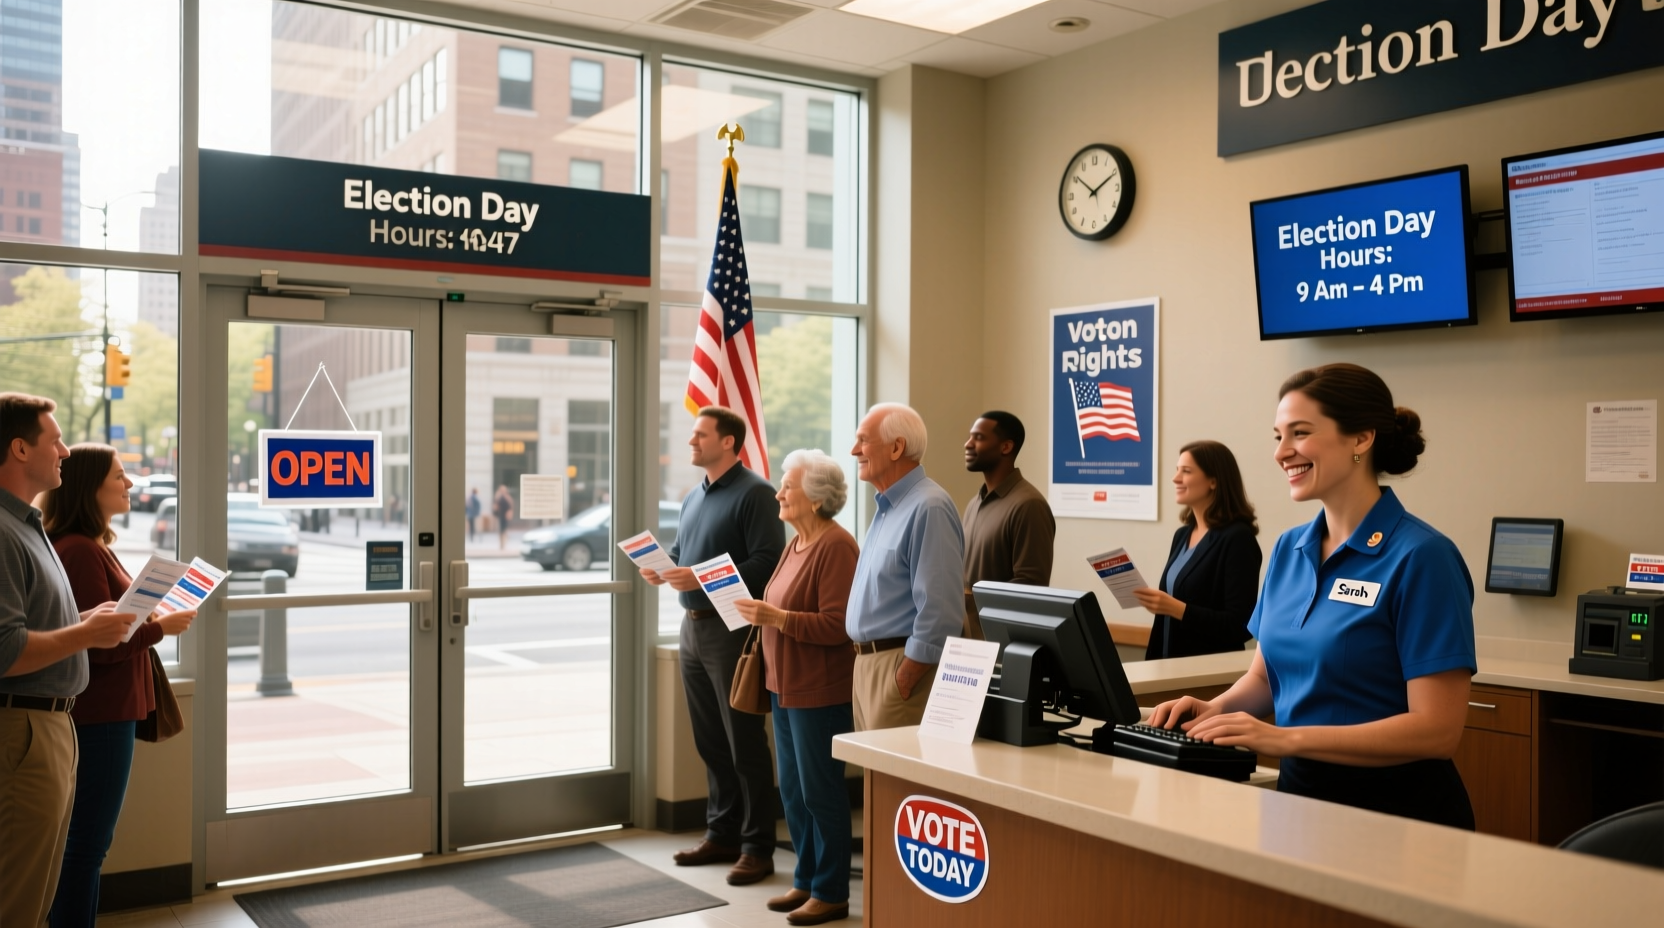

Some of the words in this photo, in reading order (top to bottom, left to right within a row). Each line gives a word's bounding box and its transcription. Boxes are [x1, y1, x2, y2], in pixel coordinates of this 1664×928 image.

[344, 179, 471, 219] Election
[481, 191, 540, 232] Day
[370, 219, 454, 250] Hours:
[1278, 215, 1377, 250] Election
[1384, 209, 1436, 239] Day
[1320, 245, 1393, 270] Hours:
[1296, 281, 1309, 303] 9
[1314, 279, 1348, 301] Am
[1369, 274, 1384, 295] 4
[1389, 273, 1424, 294] Pm
[1067, 317, 1138, 344] Voton
[1062, 344, 1142, 378] Rights
[270, 450, 370, 486] OPEN
[905, 804, 976, 858] VOTE
[906, 842, 975, 888] TODAY
